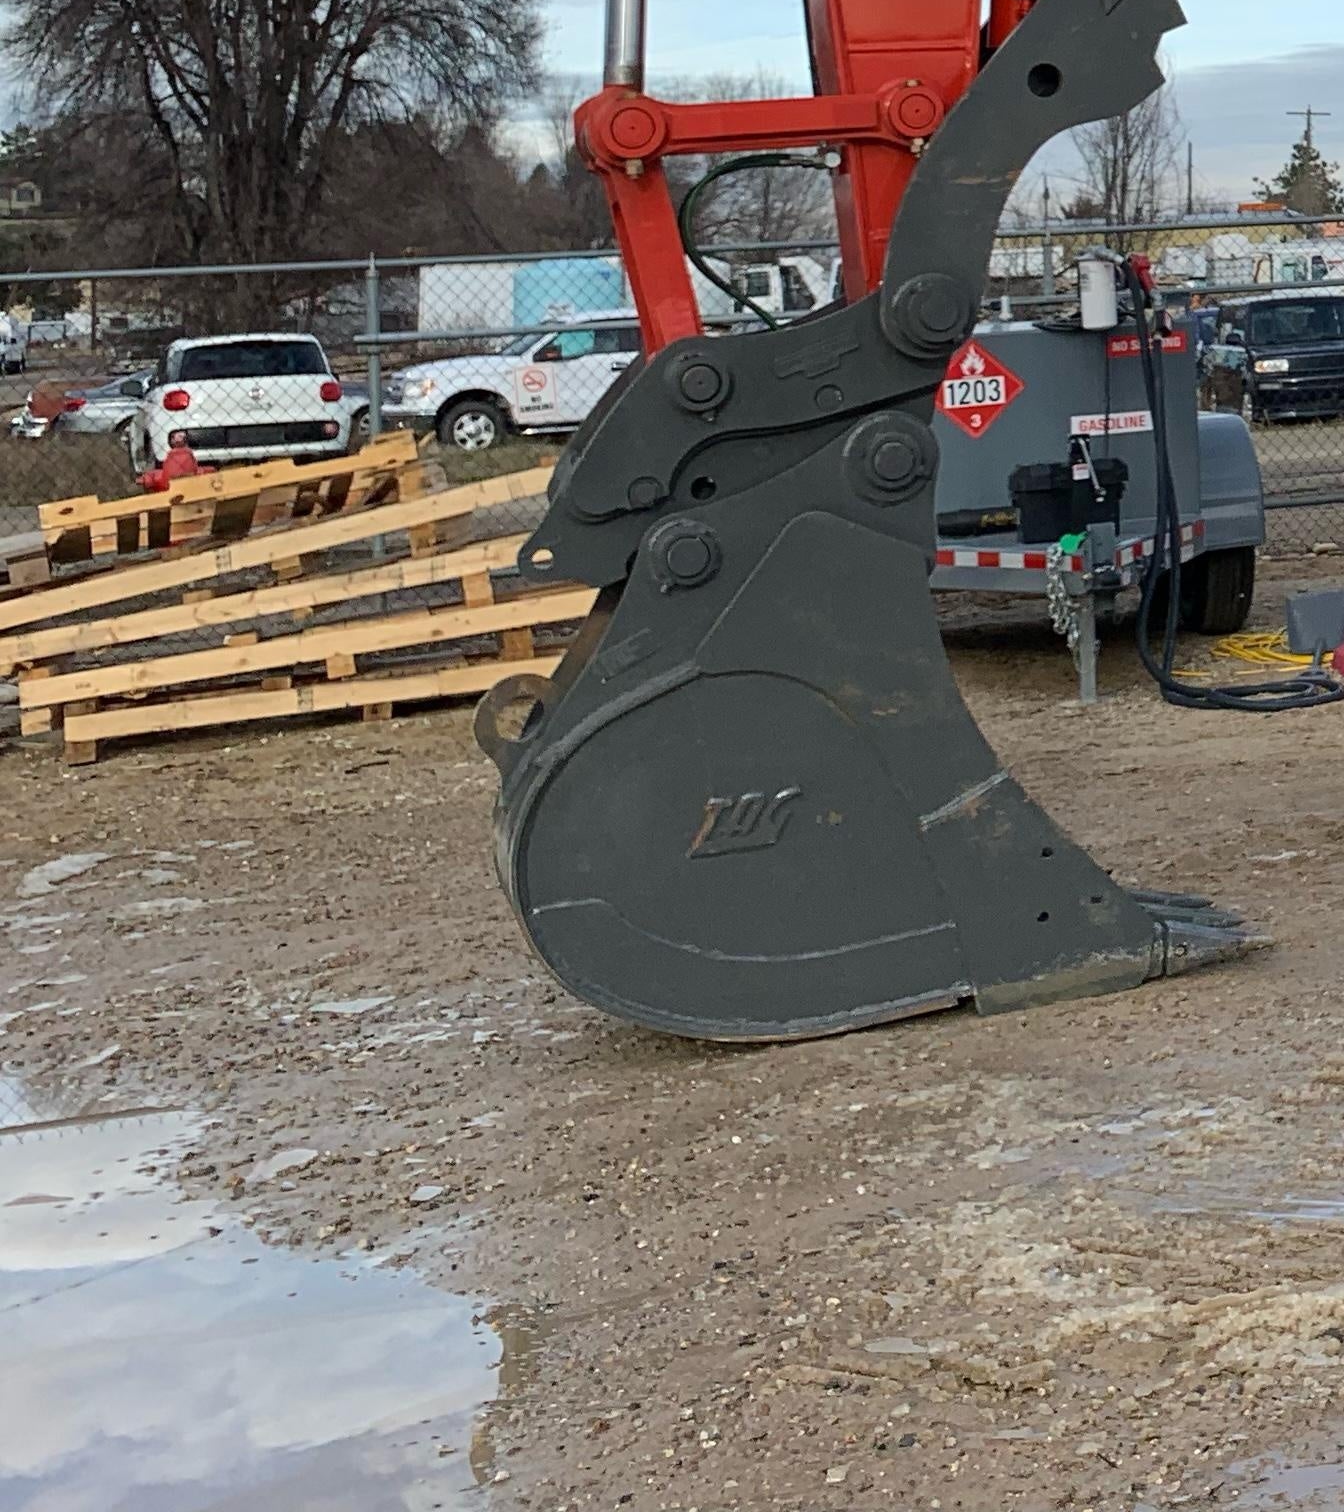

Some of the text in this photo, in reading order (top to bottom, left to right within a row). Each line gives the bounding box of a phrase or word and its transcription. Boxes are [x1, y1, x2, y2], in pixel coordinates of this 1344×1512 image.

[1112, 340, 1128, 352] NO
[946, 378, 1002, 406] 1203
[969, 413, 982, 428] 3
[1078, 414, 1146, 432] GASOLINE
